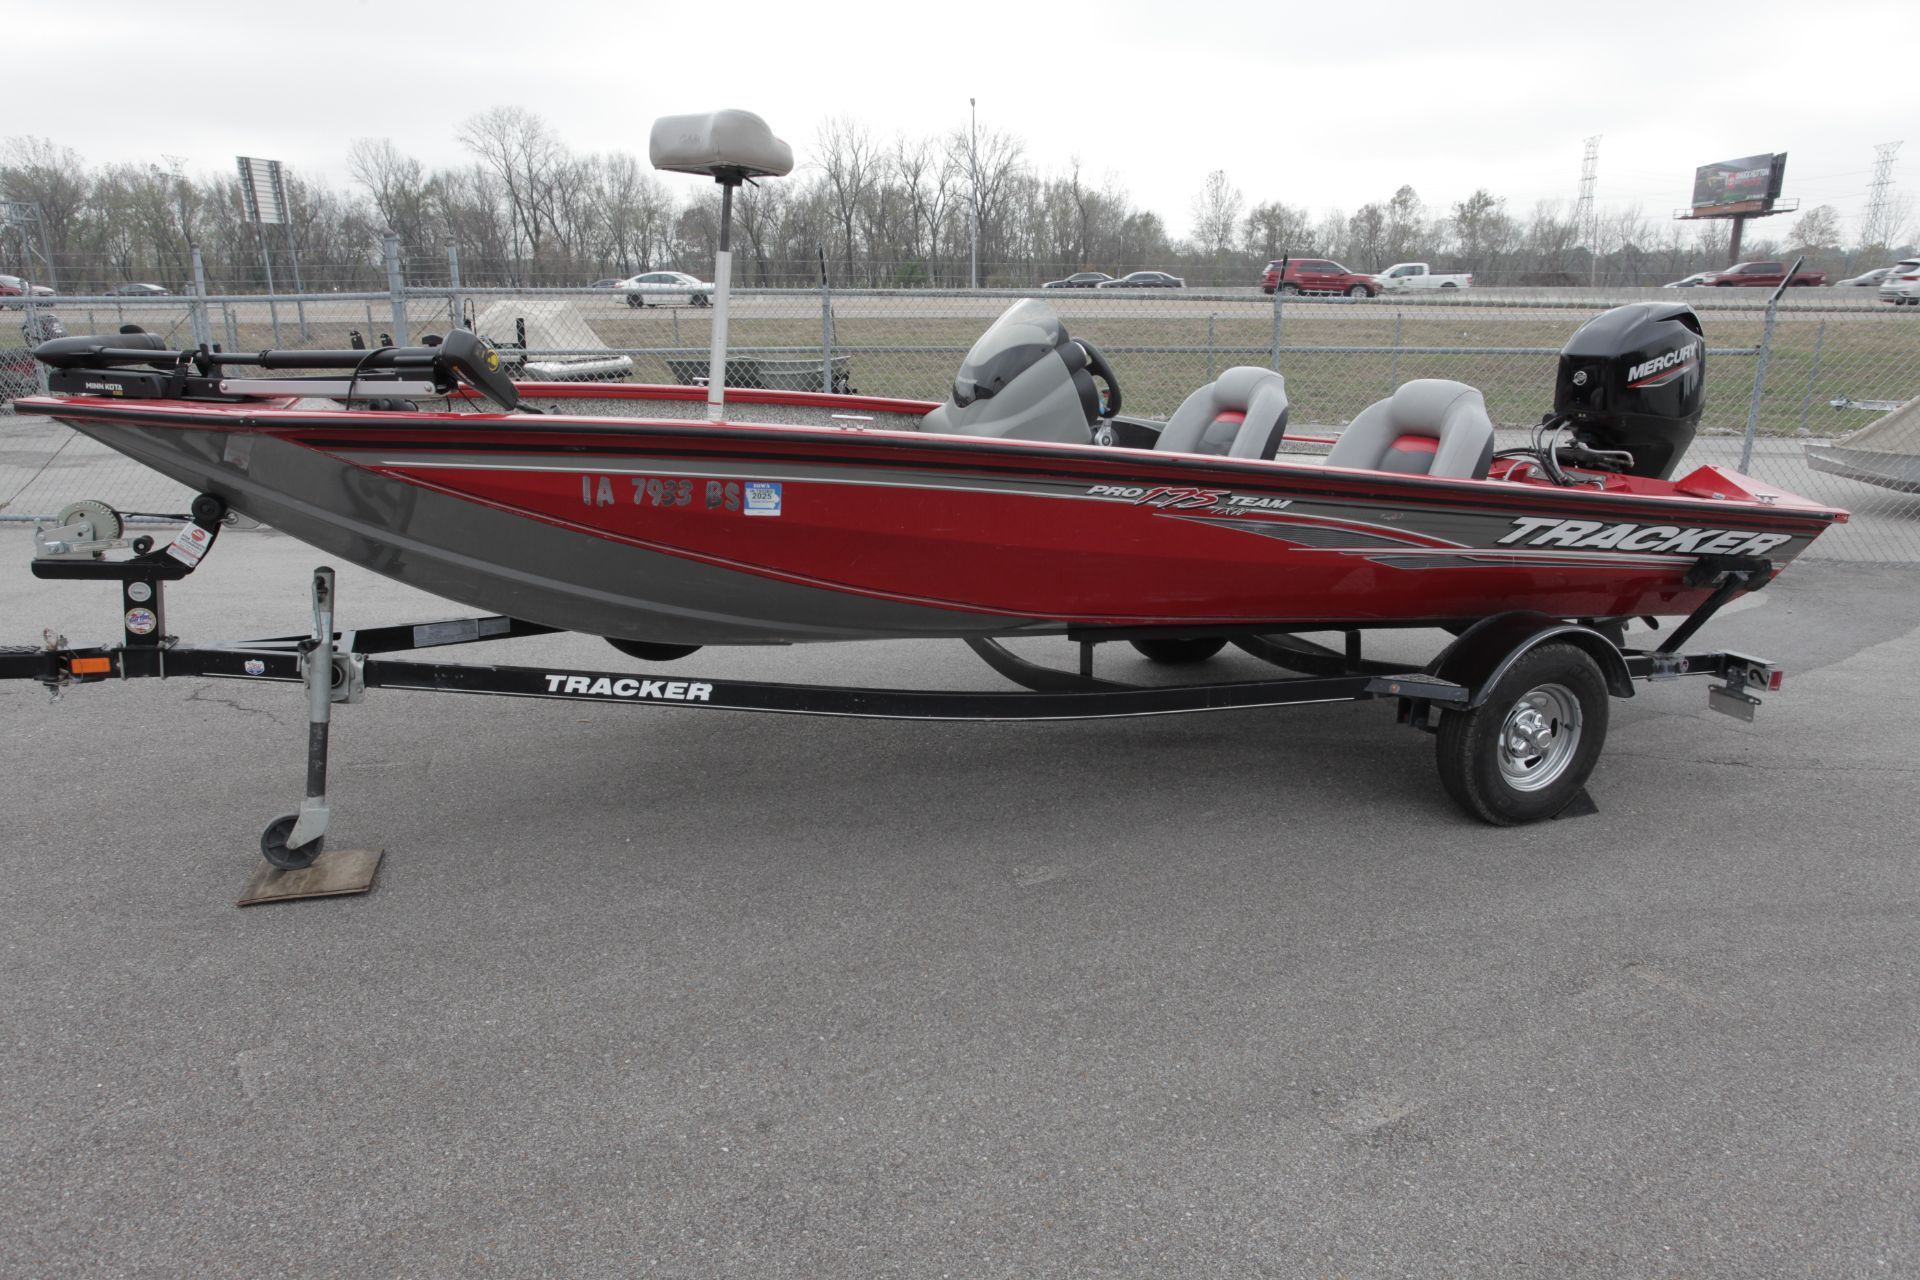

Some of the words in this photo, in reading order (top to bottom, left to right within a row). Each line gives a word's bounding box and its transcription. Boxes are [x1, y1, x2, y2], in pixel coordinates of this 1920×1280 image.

[1627, 341, 1698, 382] MERCURY
[85, 382, 104, 390] MINN
[105, 383, 123, 391] KOTA
[582, 475, 615, 507] IA
[752, 492, 772, 500] 2025
[1086, 485, 1144, 498] PRO
[1134, 486, 1232, 509] 175
[1227, 495, 1294, 509] TEAM
[1496, 516, 1793, 556] TRACKER
[545, 674, 713, 701] TRACKER
